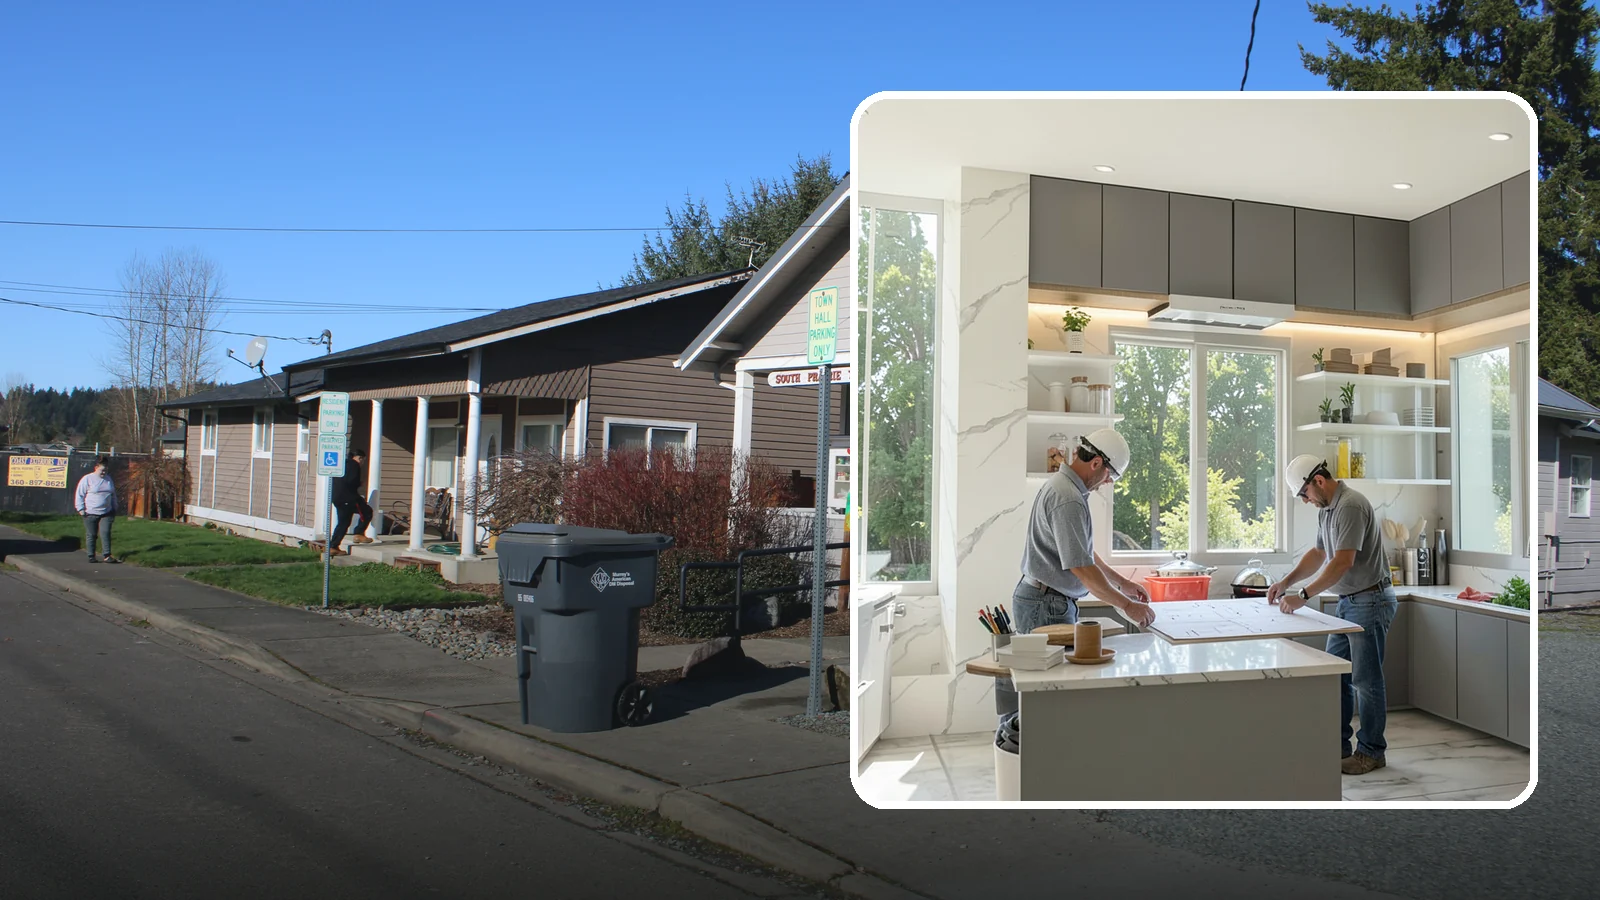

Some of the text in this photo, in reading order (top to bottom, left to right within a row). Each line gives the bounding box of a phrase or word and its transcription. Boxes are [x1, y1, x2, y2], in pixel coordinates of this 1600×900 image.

[815, 295, 833, 308] TOWN
[814, 311, 831, 324] HALL
[809, 326, 836, 340] PARKING
[813, 344, 831, 357] ONLY
[775, 373, 801, 384] SOUTH
[807, 370, 842, 382] PRIE
[10, 479, 65, 487] 360-897-8625
